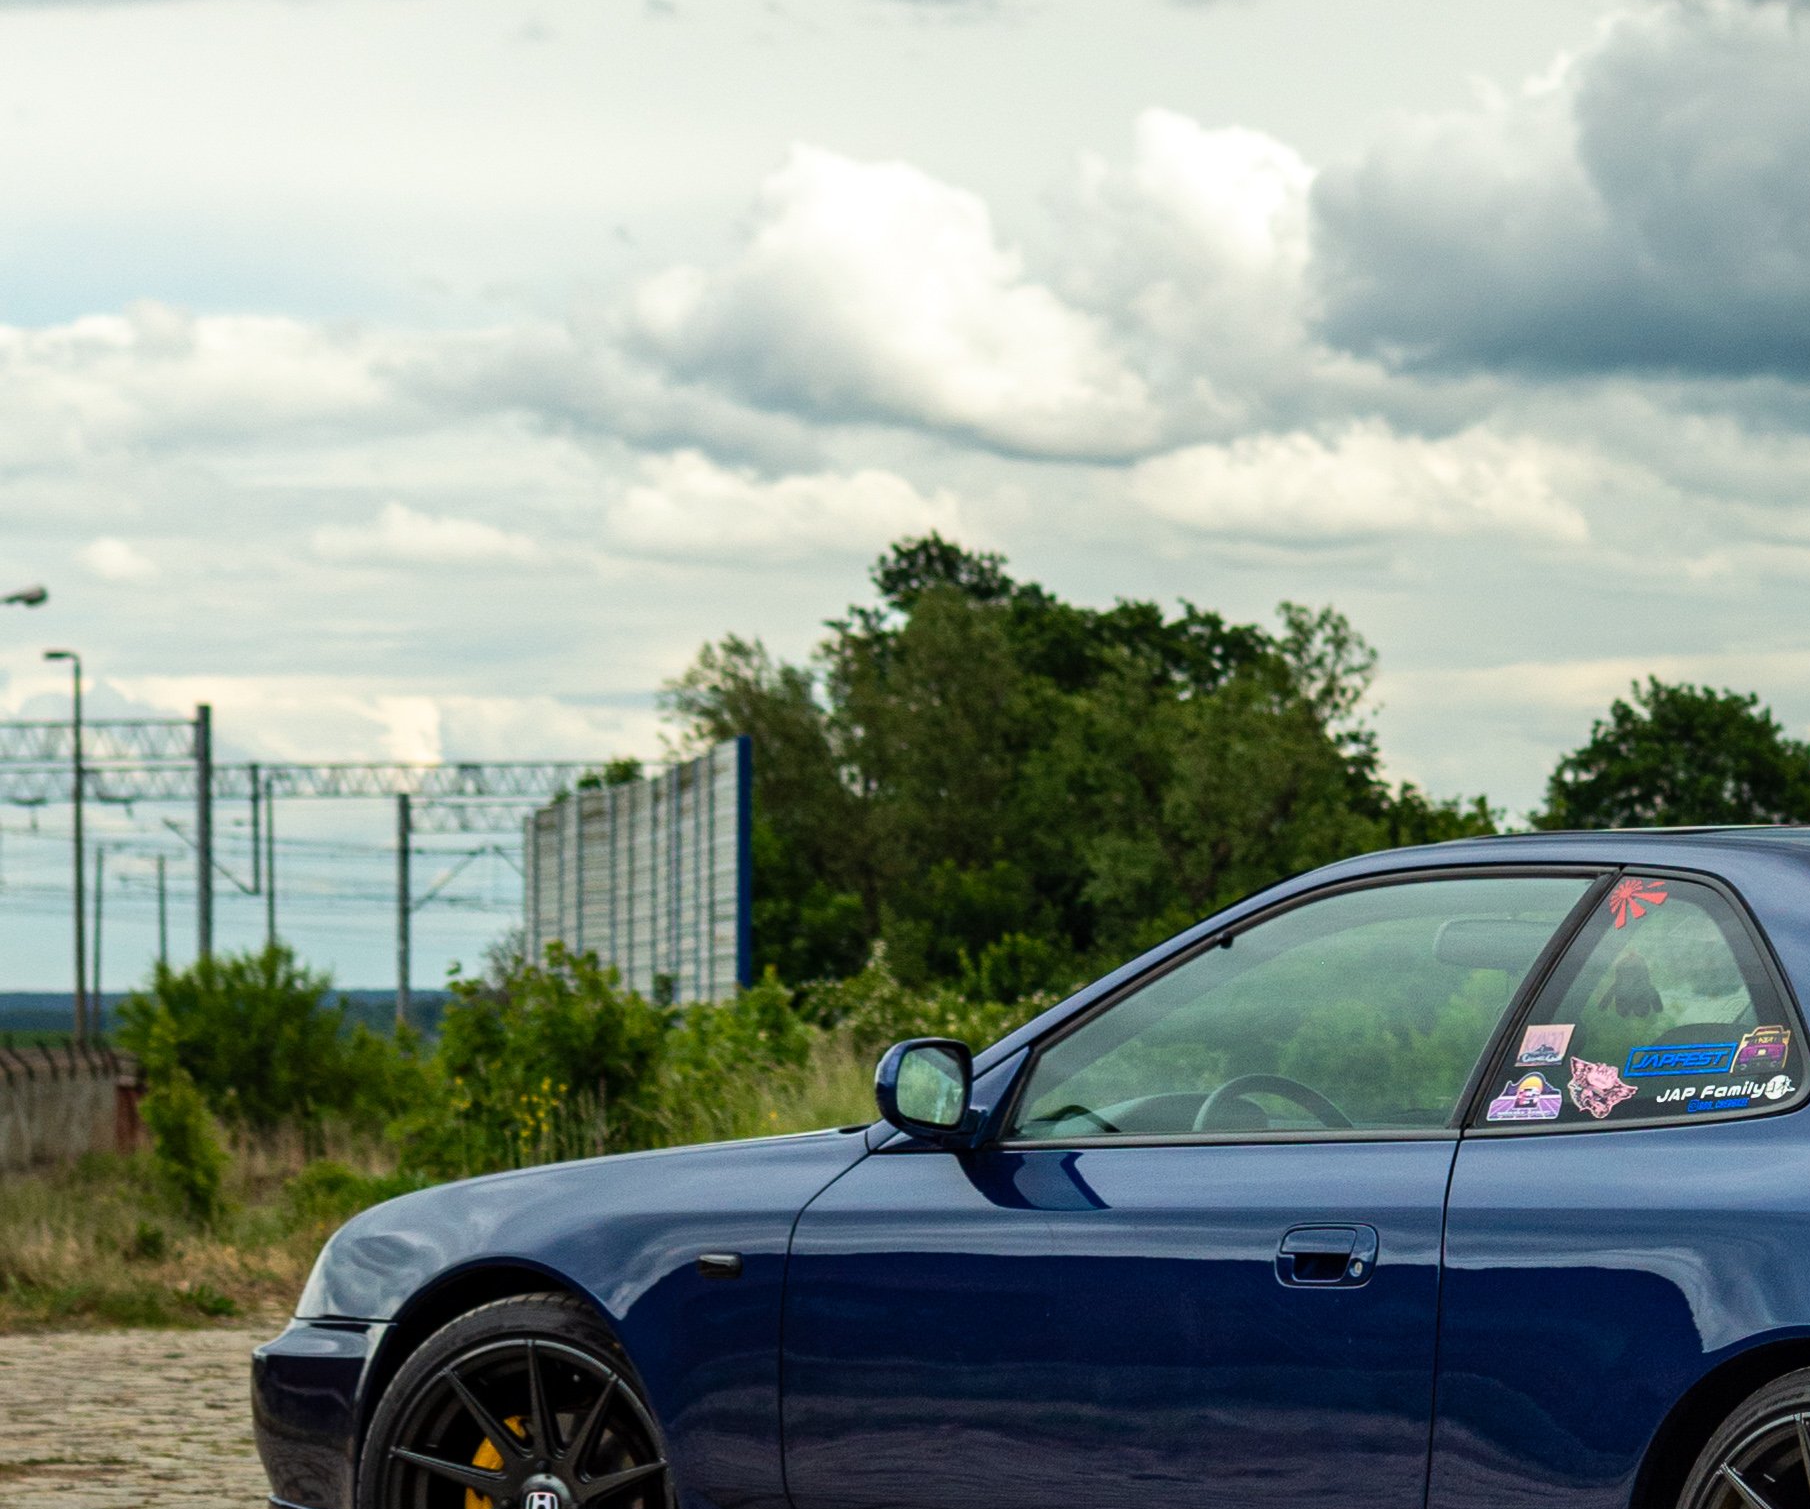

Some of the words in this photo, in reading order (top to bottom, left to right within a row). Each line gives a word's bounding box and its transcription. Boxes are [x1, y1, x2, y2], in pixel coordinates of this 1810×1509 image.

[1632, 1050, 1729, 1069] JAPFEST
[1656, 1087, 1697, 1103] JAP
[1700, 1080, 1766, 1100] Family
